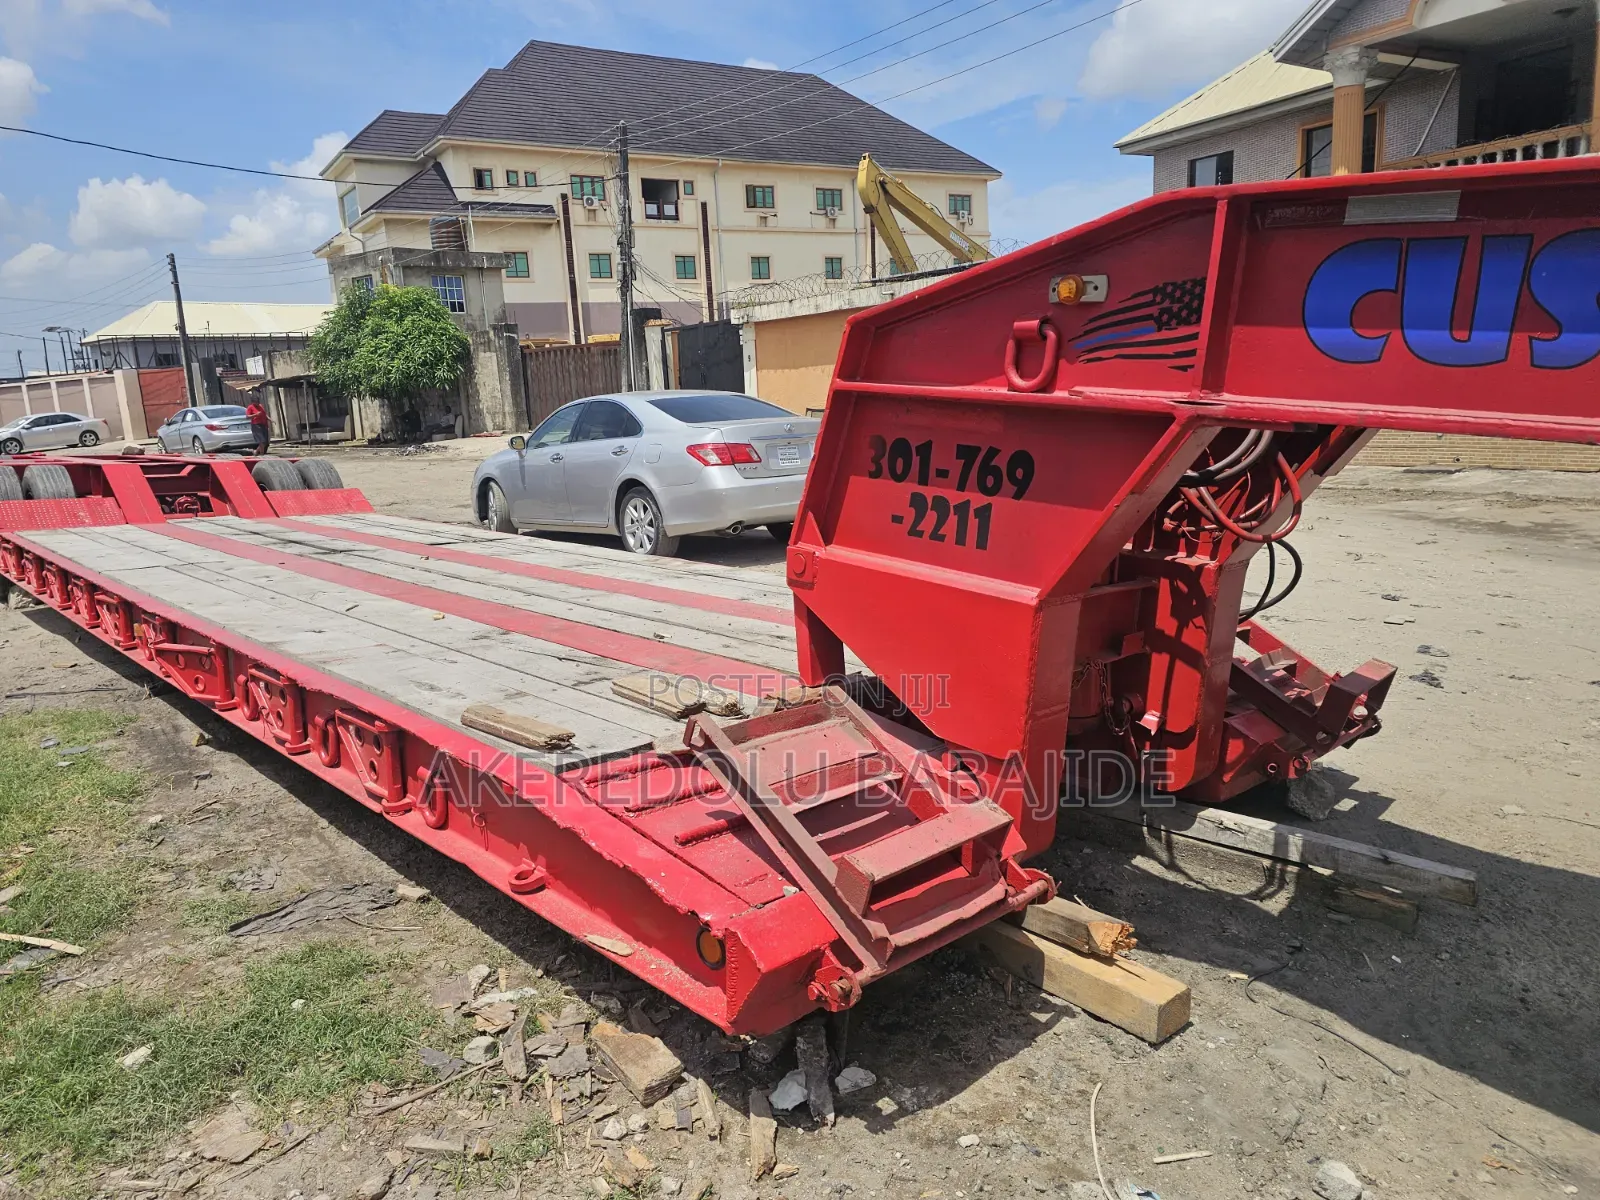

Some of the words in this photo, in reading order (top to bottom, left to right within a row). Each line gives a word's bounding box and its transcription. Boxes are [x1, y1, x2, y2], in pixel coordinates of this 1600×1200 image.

[1302, 227, 1600, 370] CUS
[867, 434, 1035, 501] 301-769
[891, 491, 993, 551] -2211
